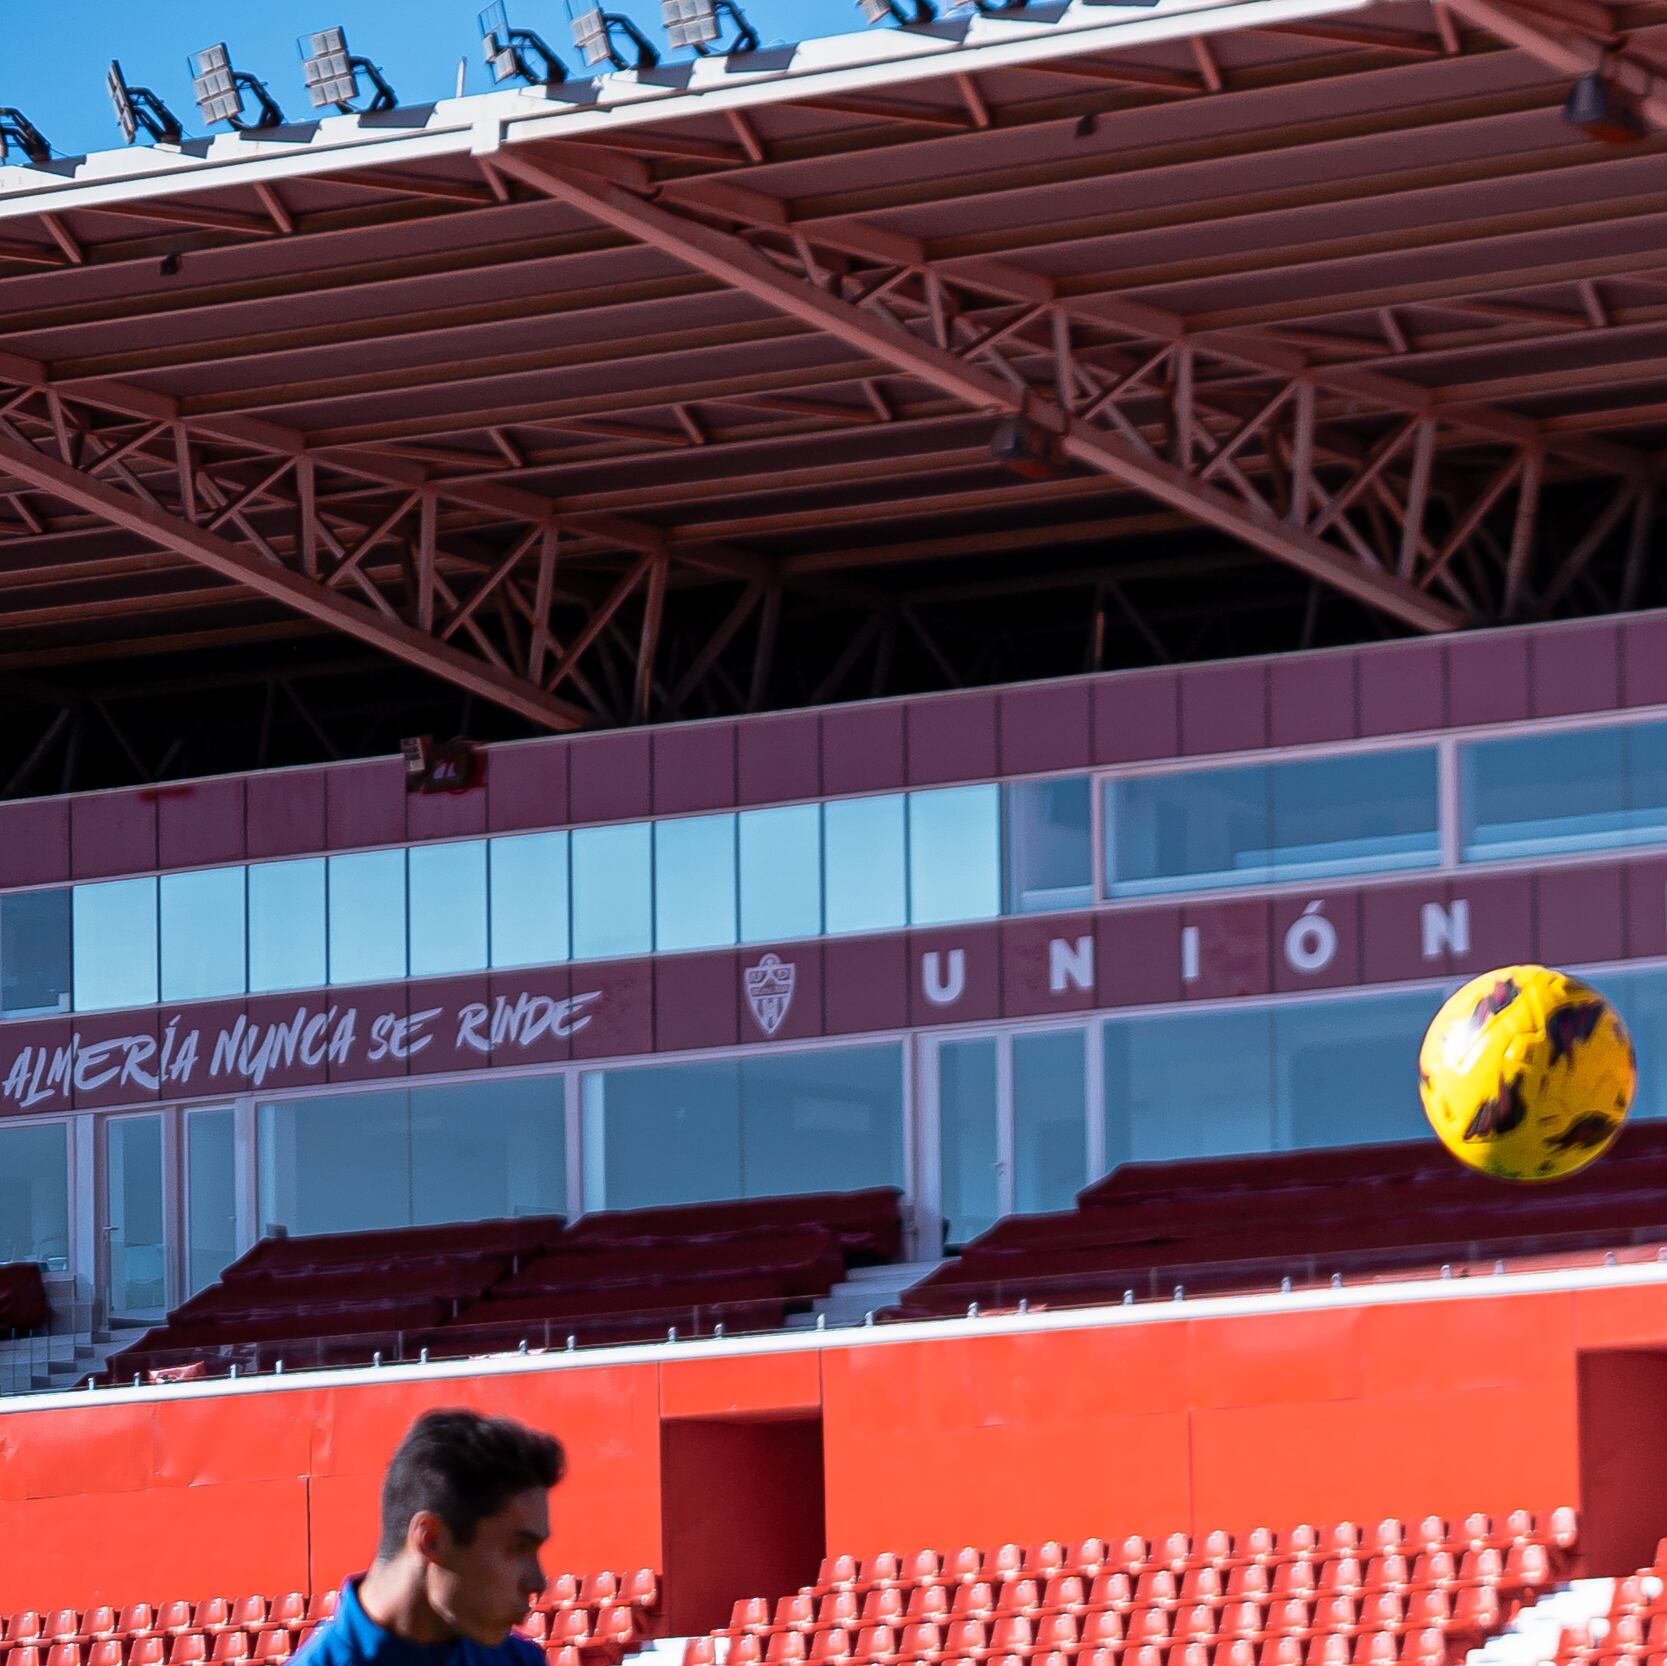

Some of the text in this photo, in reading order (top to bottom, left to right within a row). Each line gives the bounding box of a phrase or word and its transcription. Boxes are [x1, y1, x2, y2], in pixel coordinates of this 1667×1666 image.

[920, 899, 1471, 1003] UNIÓN
[2, 990, 603, 1109] ALMERÍA NUNCA SE RINDE
